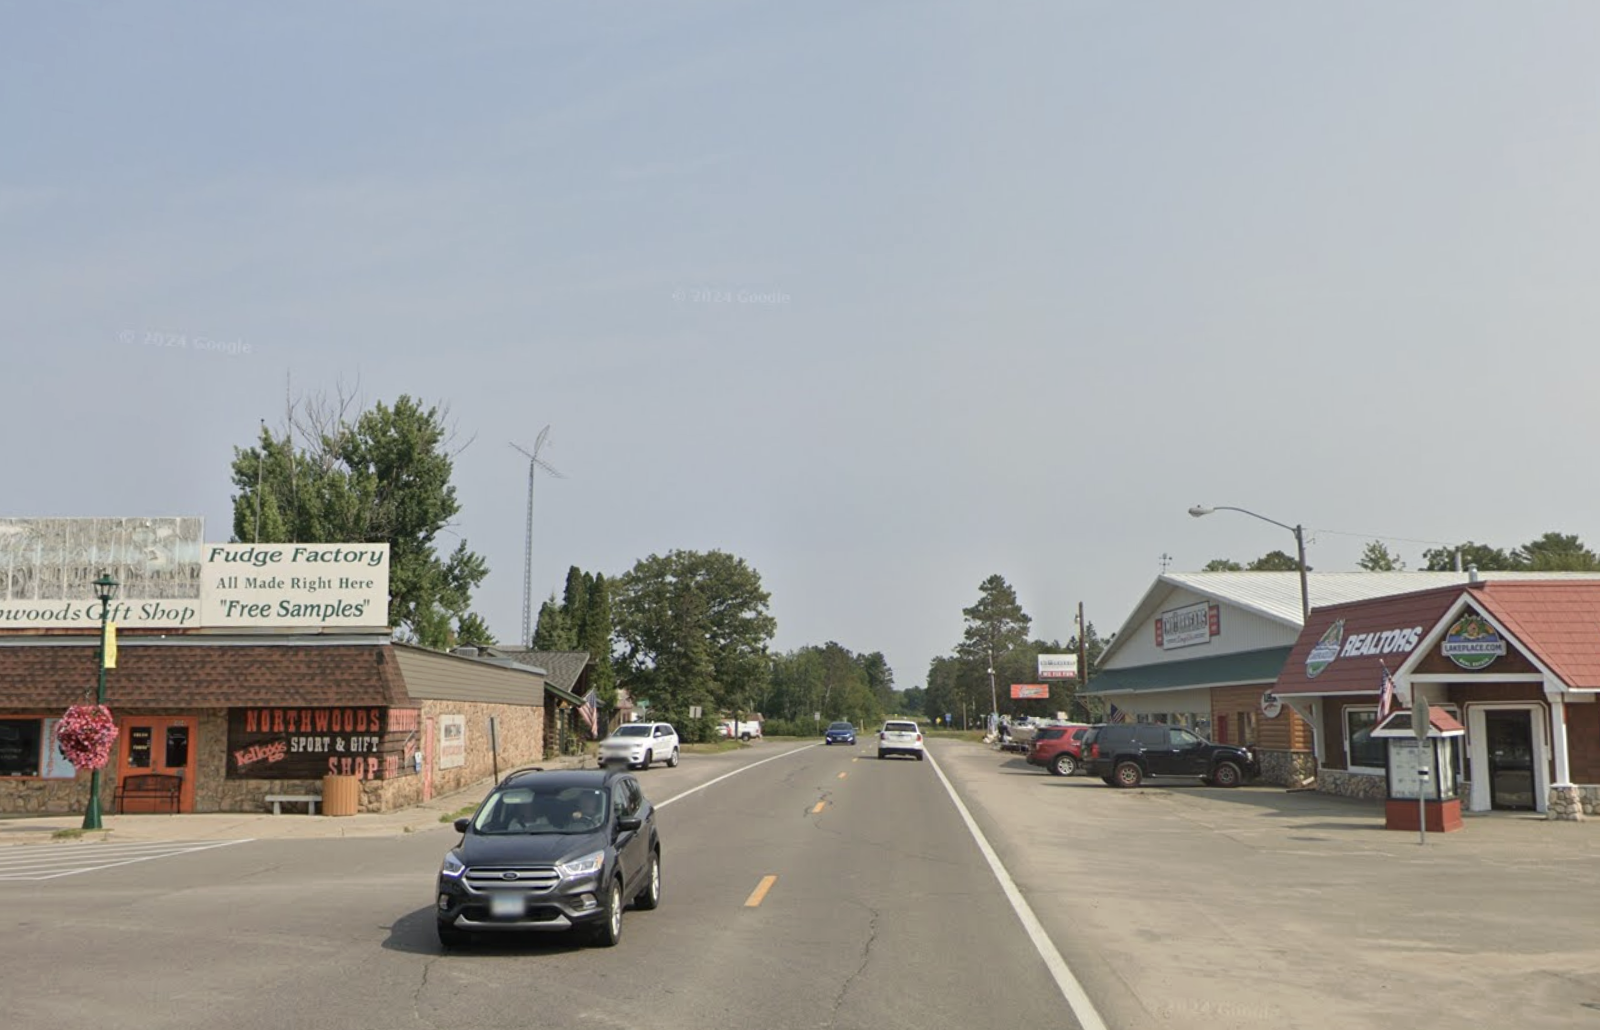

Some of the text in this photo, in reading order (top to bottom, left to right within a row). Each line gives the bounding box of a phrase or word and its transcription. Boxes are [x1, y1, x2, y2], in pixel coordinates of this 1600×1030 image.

[208, 547, 384, 567] Fudge Factory
[216, 576, 374, 592] All Made Right Here
[85, 602, 132, 622] Gift
[139, 602, 195, 625] Shop
[220, 598, 370, 622] "Free Samples"
[1340, 626, 1423, 658] REALTORS
[1444, 643, 1503, 653] LAKEPLACE.COM
[246, 709, 380, 733] NORTHWOODS
[290, 736, 380, 753] SPORT & GIFT
[328, 756, 379, 780] SHOP
